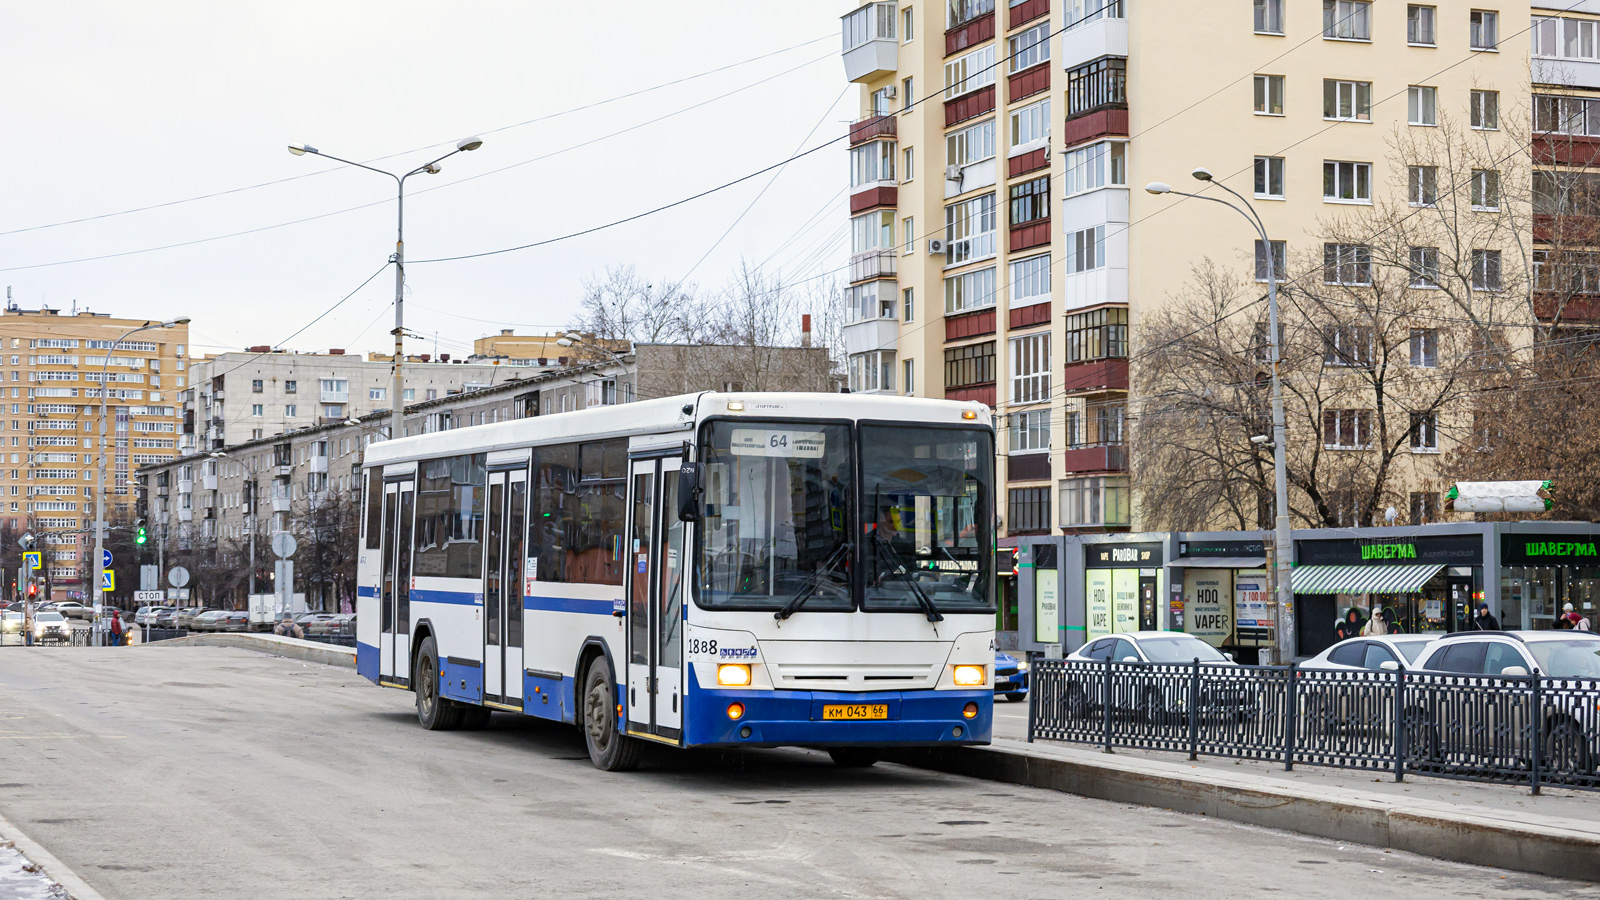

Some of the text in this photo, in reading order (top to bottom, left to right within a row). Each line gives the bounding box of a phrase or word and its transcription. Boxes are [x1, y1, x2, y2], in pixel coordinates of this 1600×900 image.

[769, 434, 788, 448] 64
[1361, 543, 1418, 560] ШАВЕРМА
[1525, 541, 1598, 557] ШАВЕРМА
[138, 592, 160, 600] СТОП
[1197, 589, 1219, 604] HDQ
[1242, 592, 1247, 602] 2
[1248, 592, 1259, 602] 100
[1092, 613, 1107, 627] VAPE
[689, 638, 718, 655] 1888
[846, 705, 868, 718] 043
[872, 704, 884, 714] 66
